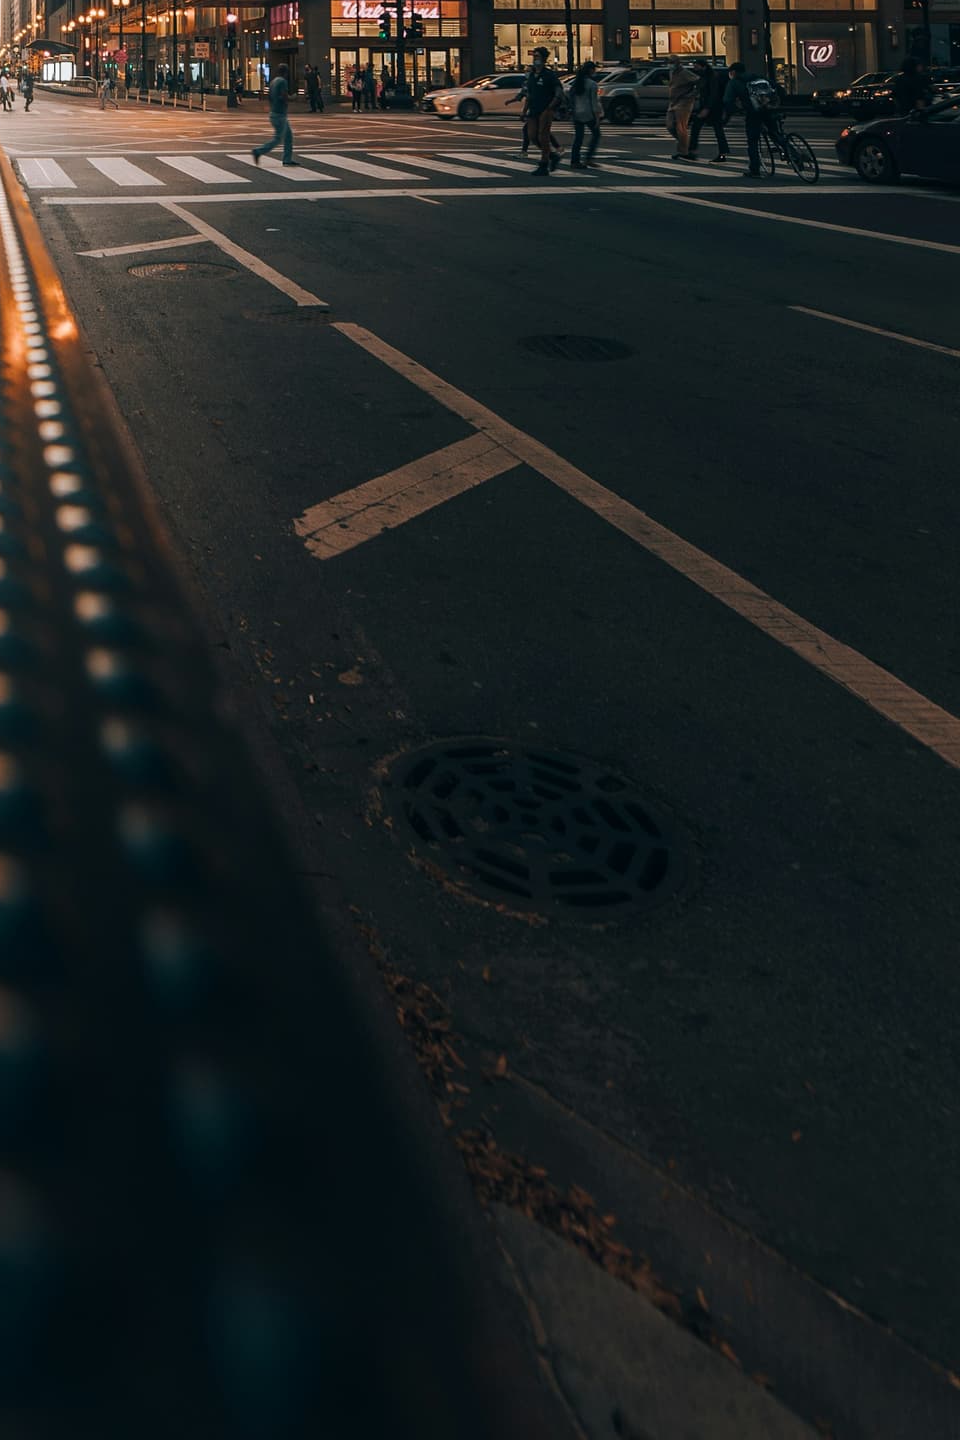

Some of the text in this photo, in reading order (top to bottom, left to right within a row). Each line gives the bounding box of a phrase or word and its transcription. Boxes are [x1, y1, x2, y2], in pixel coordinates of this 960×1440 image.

[342, 0, 440, 23] Walens
[529, 27, 574, 39] Walgrees
[807, 44, 833, 63] W
